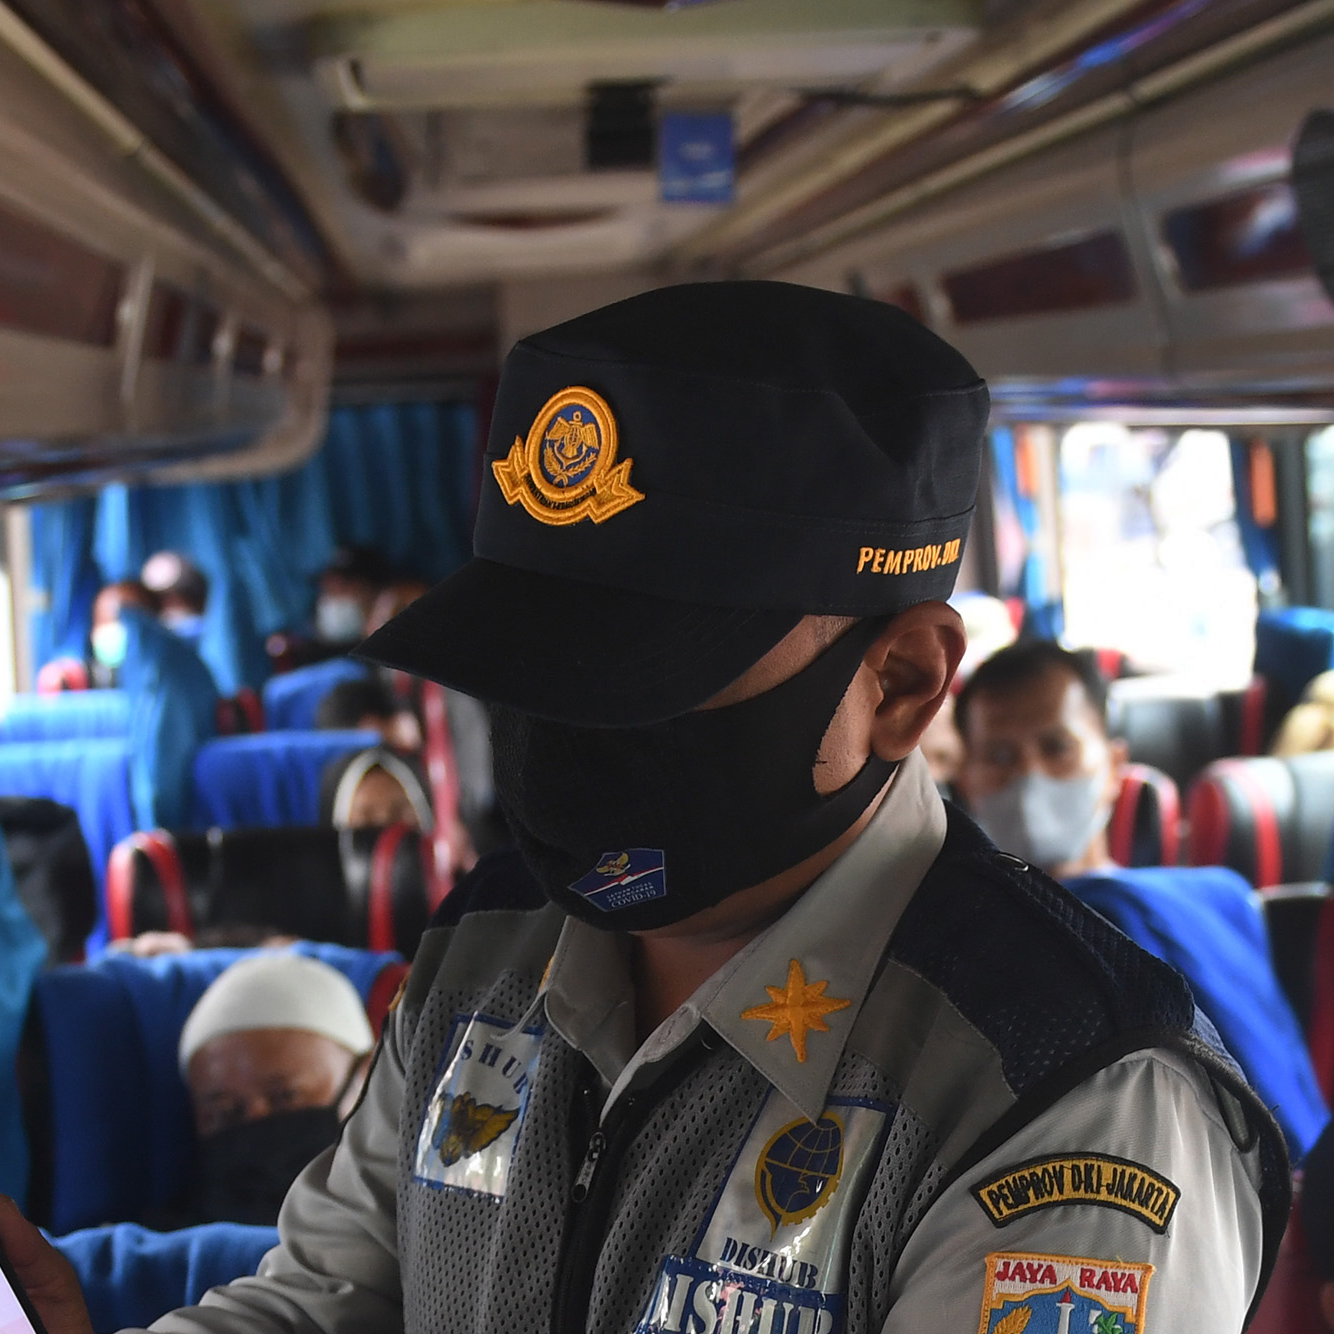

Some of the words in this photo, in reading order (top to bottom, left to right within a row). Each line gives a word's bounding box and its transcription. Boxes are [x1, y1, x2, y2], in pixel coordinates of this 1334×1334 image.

[611, 889, 656, 908] COVID-19
[461, 1040, 528, 1094] SHUB
[987, 1163, 1065, 1216] PEMPROV
[719, 1237, 819, 1289] DISHUB
[995, 1261, 1057, 1285] JAYA
[1079, 1267, 1139, 1294] RAYA
